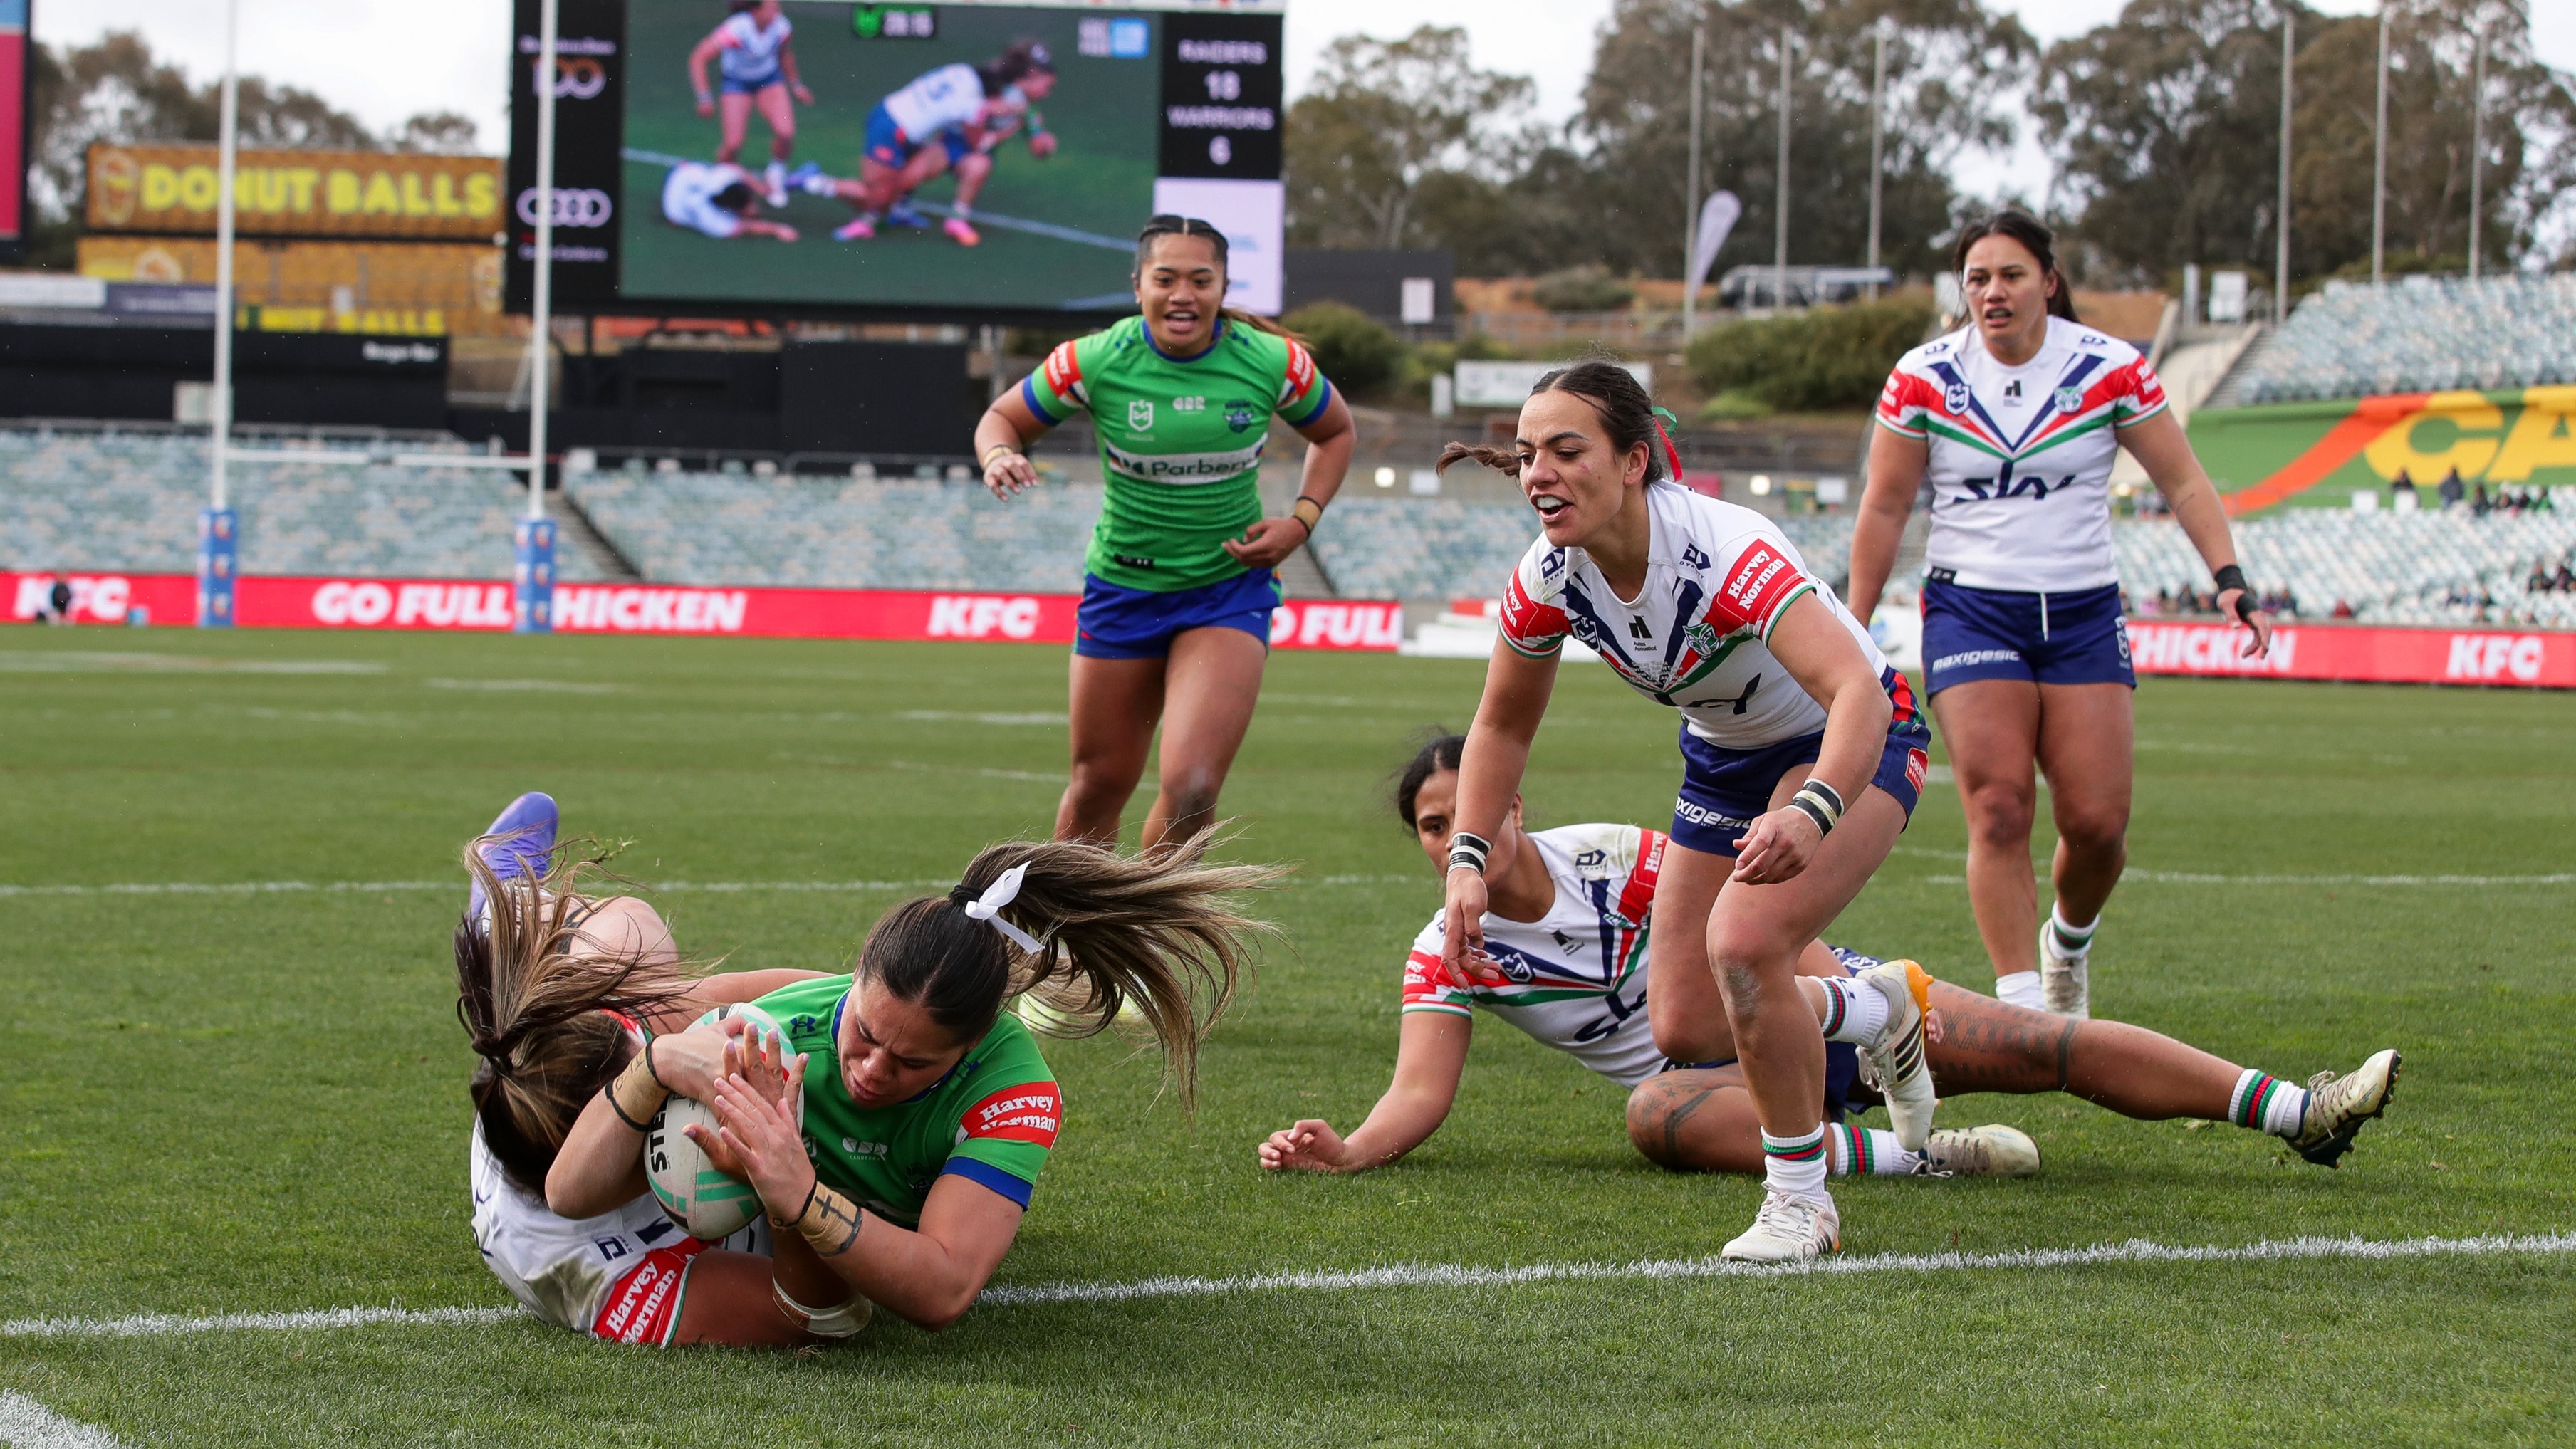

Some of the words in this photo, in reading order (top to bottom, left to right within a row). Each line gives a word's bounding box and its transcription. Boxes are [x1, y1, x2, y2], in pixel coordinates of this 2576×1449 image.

[142, 164, 320, 214] DONUT
[327, 169, 498, 219] BALLS
[1545, 570, 1564, 585] DYNA
[1728, 549, 1771, 600] Harvey
[1738, 558, 1786, 611] Norman
[312, 582, 392, 624] GO
[397, 585, 514, 627] FULL
[551, 588, 748, 632] HICKEN
[928, 597, 1040, 638] KFC
[2446, 634, 2544, 680] KFC
[1676, 796, 1751, 829] axigesic
[979, 1095, 1054, 1121] Harvey
[606, 1260, 658, 1335] Harvey
